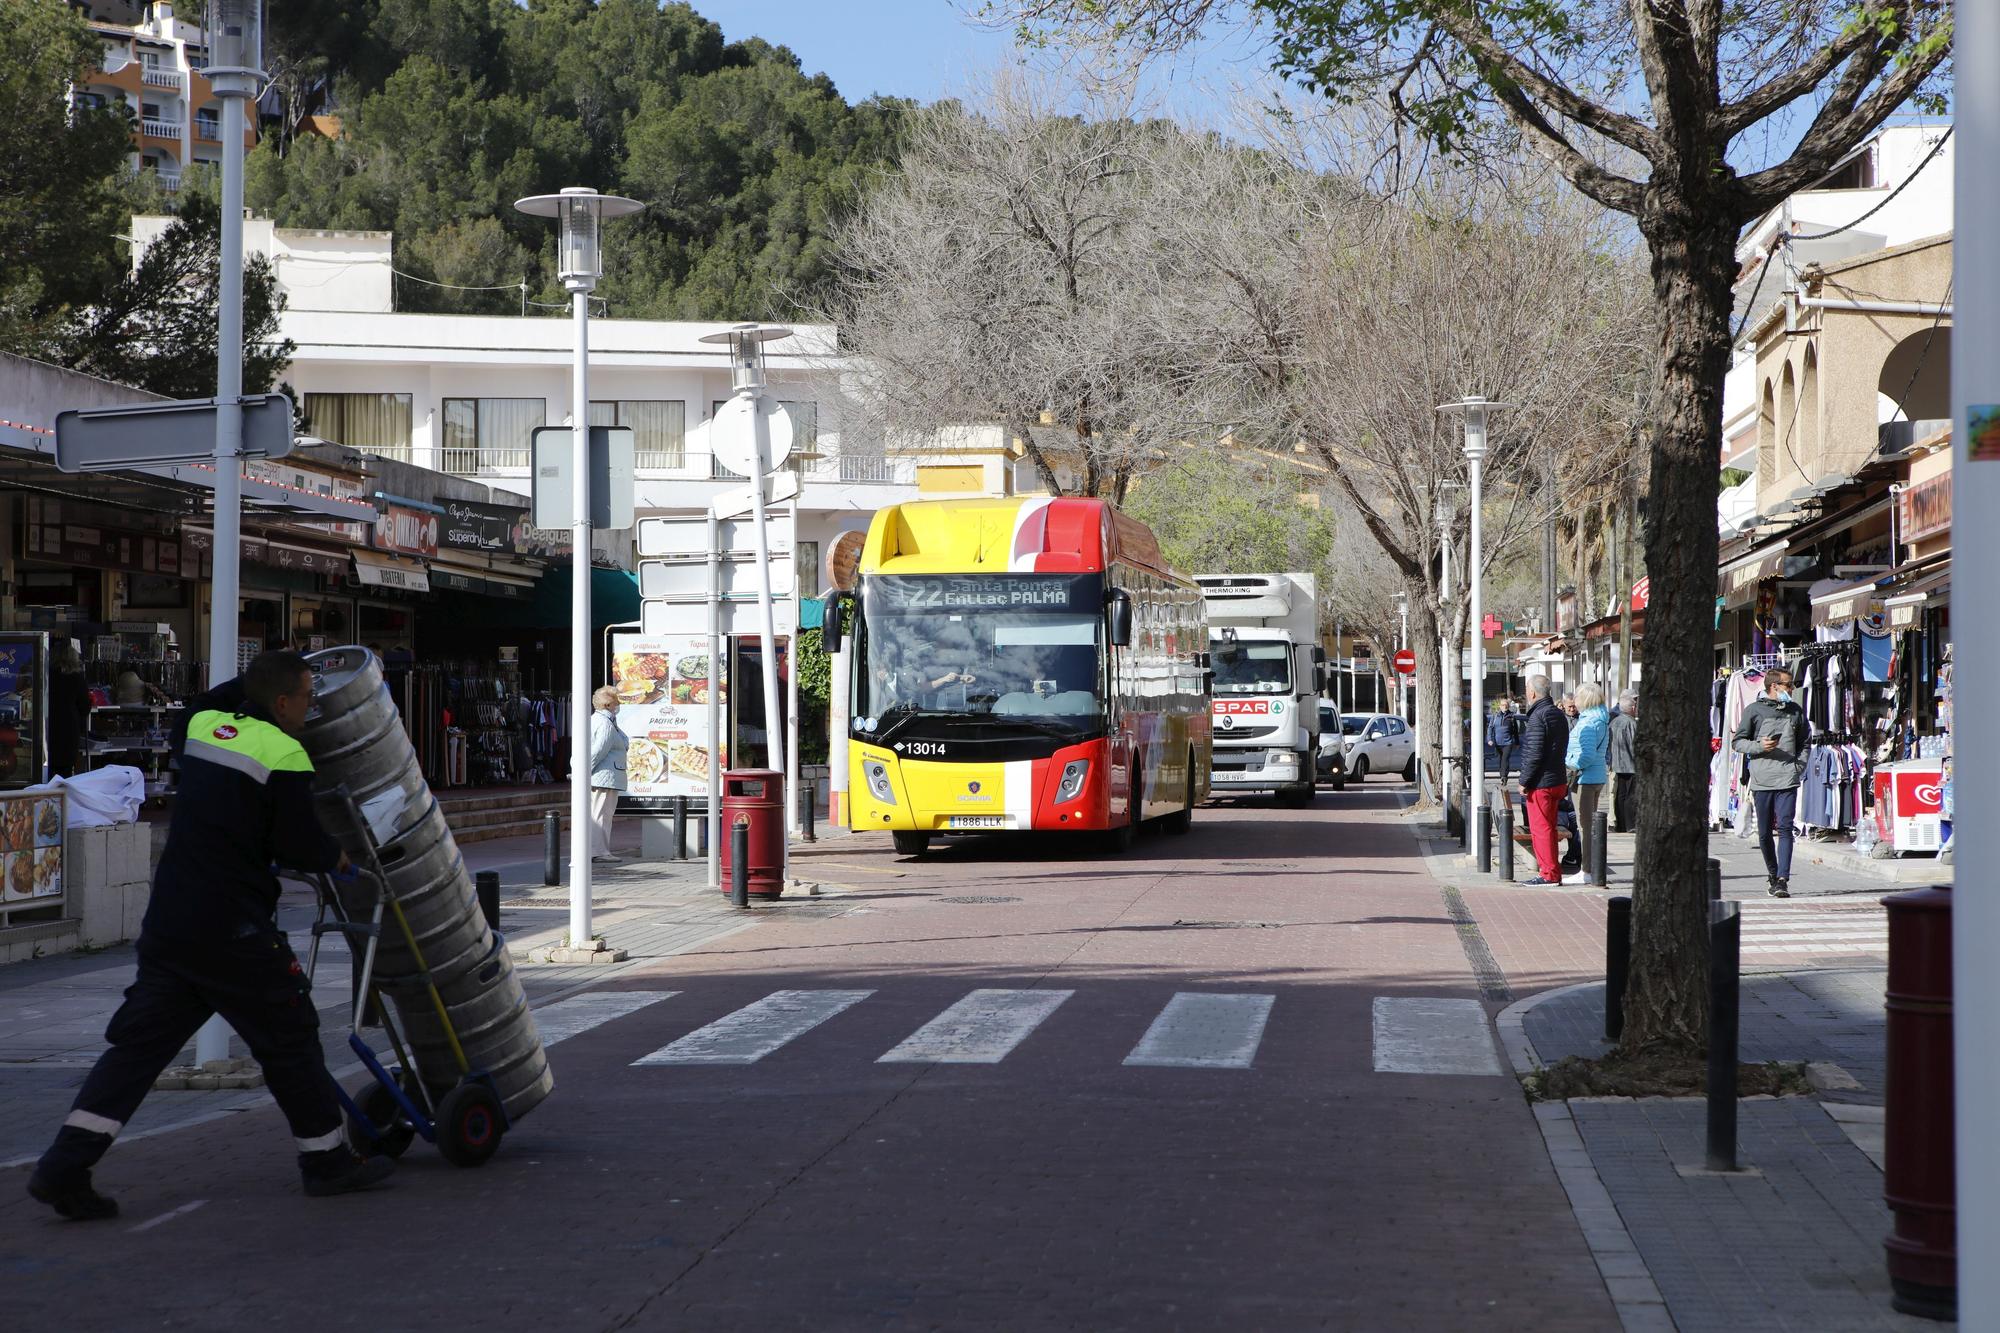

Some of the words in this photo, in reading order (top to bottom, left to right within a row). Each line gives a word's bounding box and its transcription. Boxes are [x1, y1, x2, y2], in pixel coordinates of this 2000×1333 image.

[395, 512, 420, 549] ONKAR
[522, 522, 573, 546] Desigual
[448, 529, 482, 547] Superdry
[950, 580, 1002, 592] Santa
[1011, 591, 1066, 604] PALMA
[1214, 703, 1268, 713] SPAR
[649, 717, 674, 725] PACIFIC
[674, 717, 688, 725] BAY
[906, 743, 946, 755] 13014
[957, 817, 981, 827] 1886
[983, 817, 1002, 827] LLK
